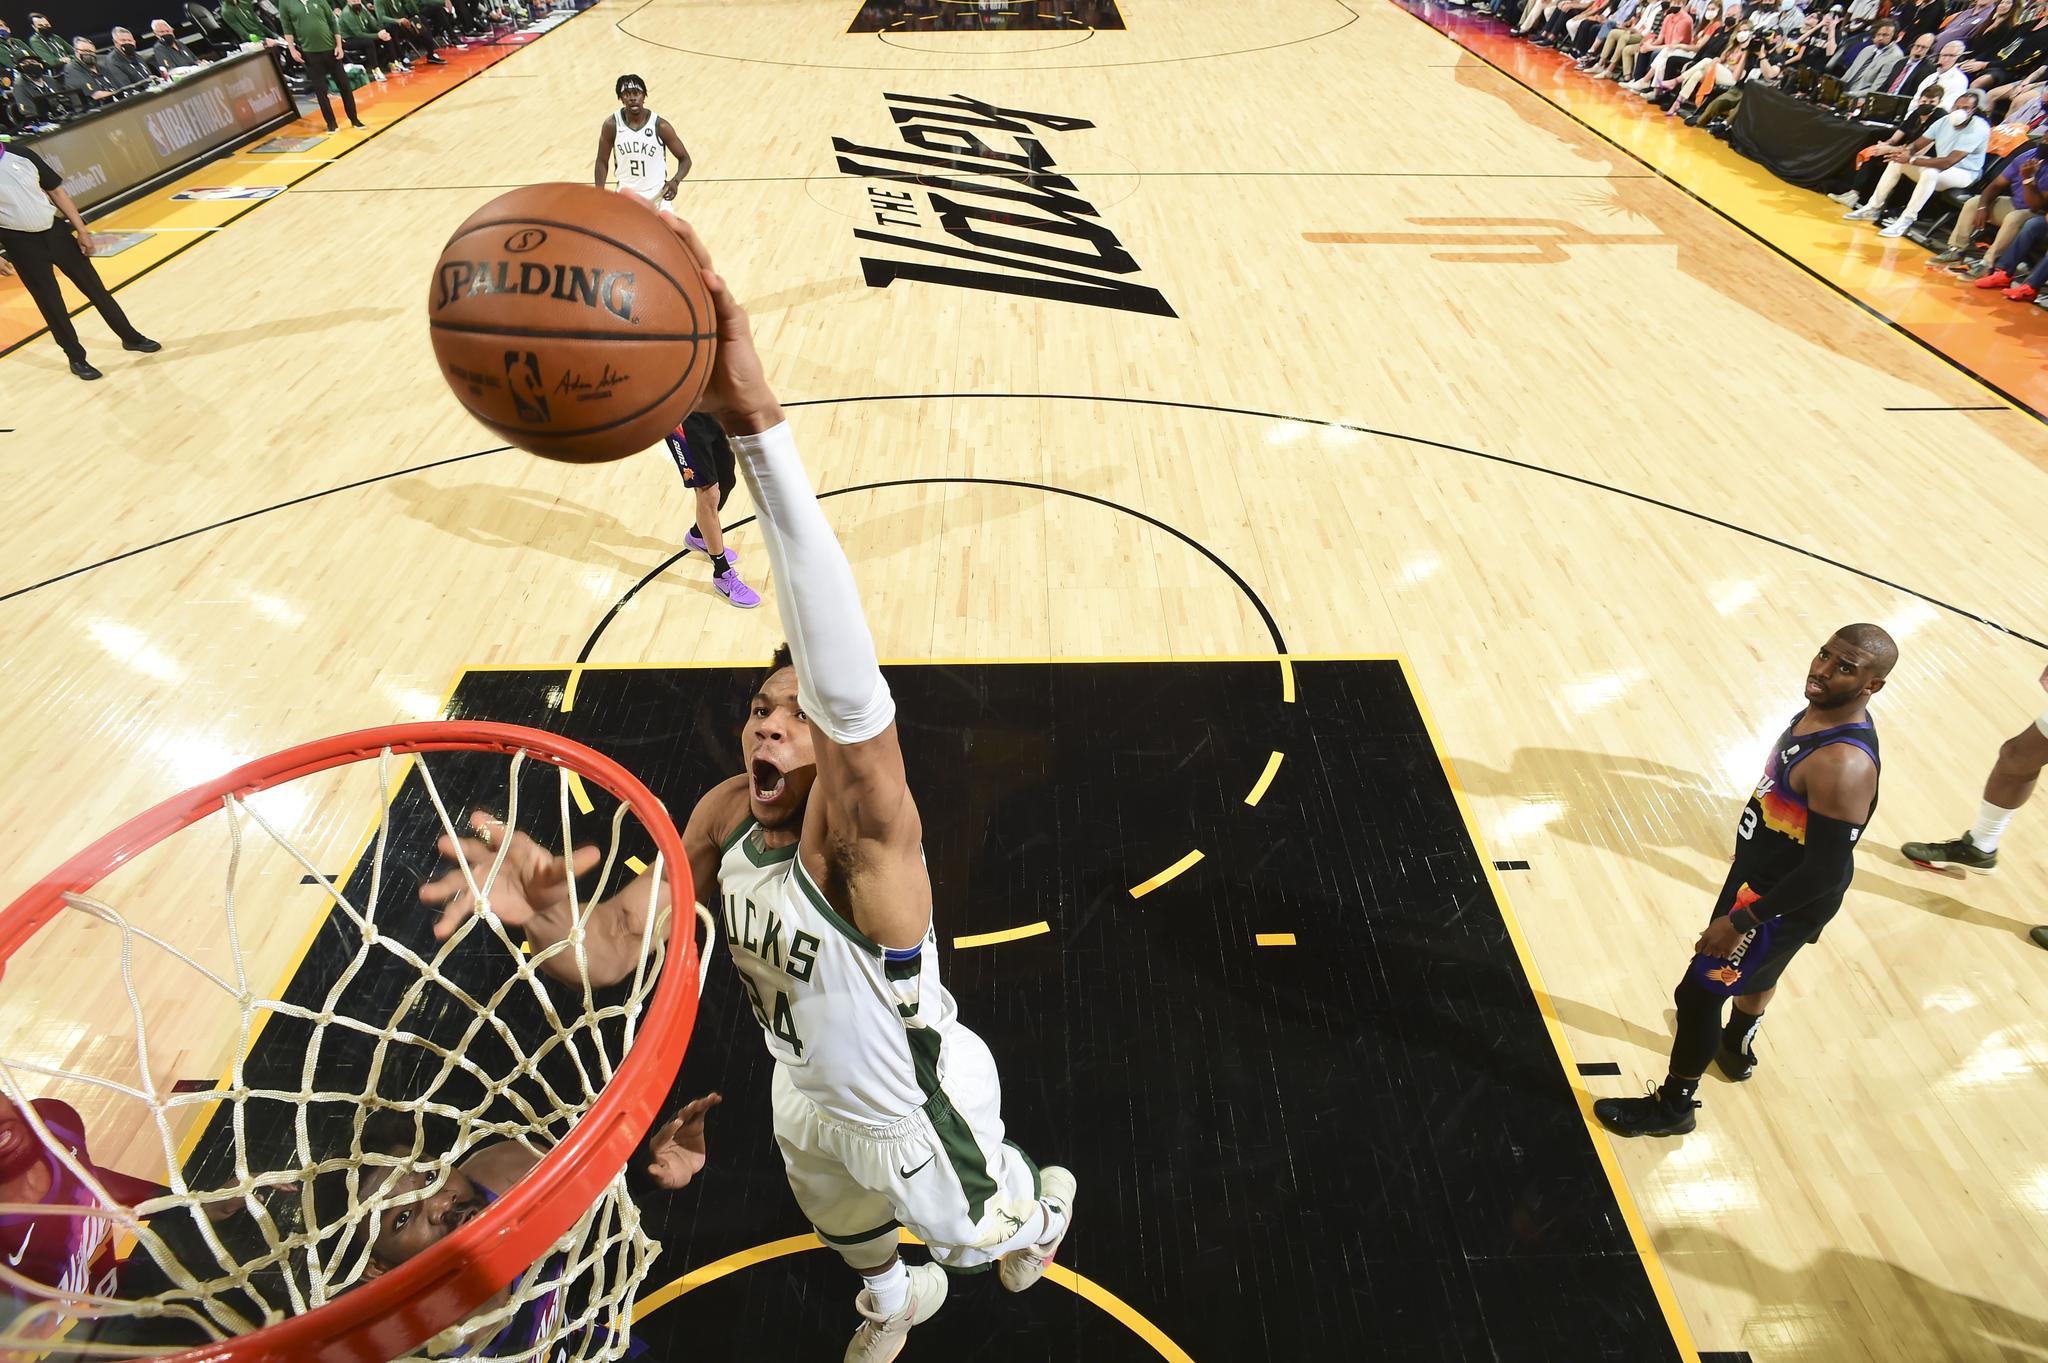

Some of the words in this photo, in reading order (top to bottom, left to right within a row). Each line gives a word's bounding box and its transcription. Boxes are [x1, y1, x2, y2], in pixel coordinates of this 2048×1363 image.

[156, 98, 196, 151] NBA
[190, 86, 234, 140] FINALS
[617, 141, 657, 157] BUCKS
[630, 159, 646, 177] 21
[868, 187, 922, 228] THE
[436, 260, 636, 321] SPALDING
[1738, 806, 1758, 841] 3
[722, 894, 821, 984] UCKS
